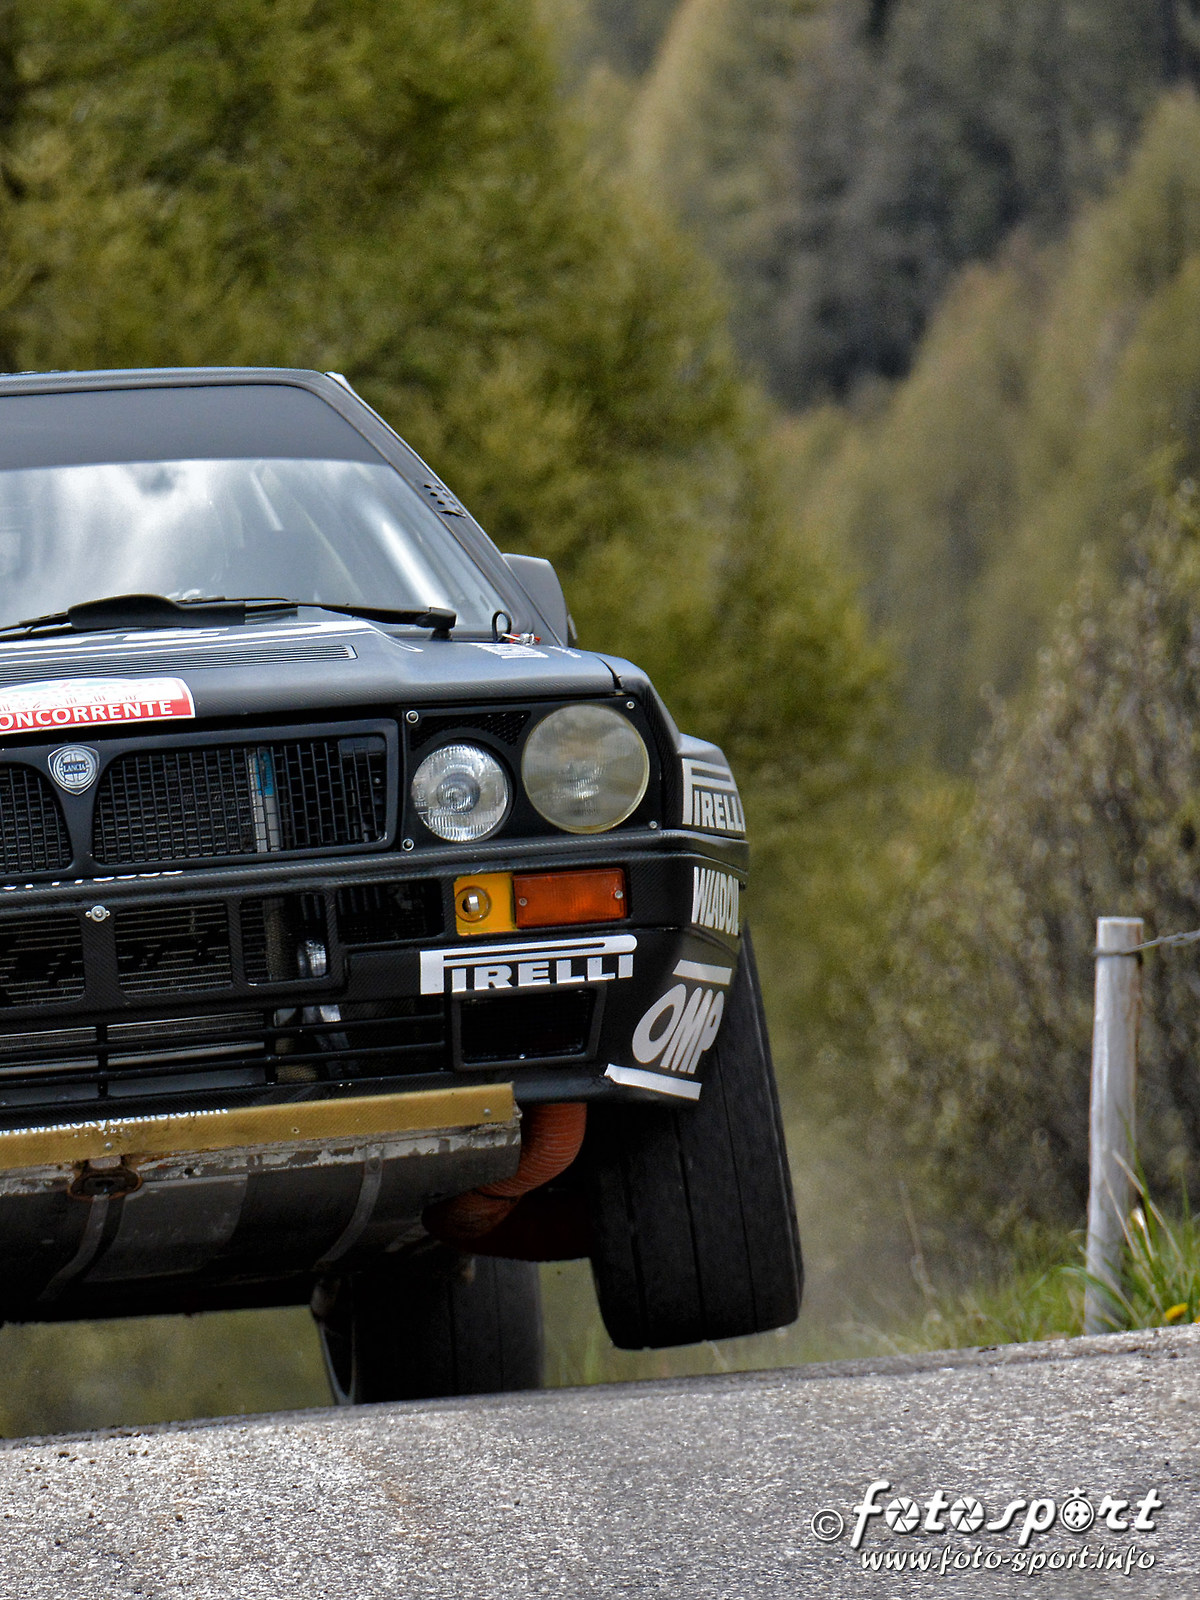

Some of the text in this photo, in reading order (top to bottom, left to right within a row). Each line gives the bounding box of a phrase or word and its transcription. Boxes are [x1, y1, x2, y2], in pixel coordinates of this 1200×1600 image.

[63, 762, 87, 773] LANCIA
[681, 757, 746, 832] PIRELLI
[419, 933, 638, 996] PIRELLI
[632, 983, 725, 1075] OMP
